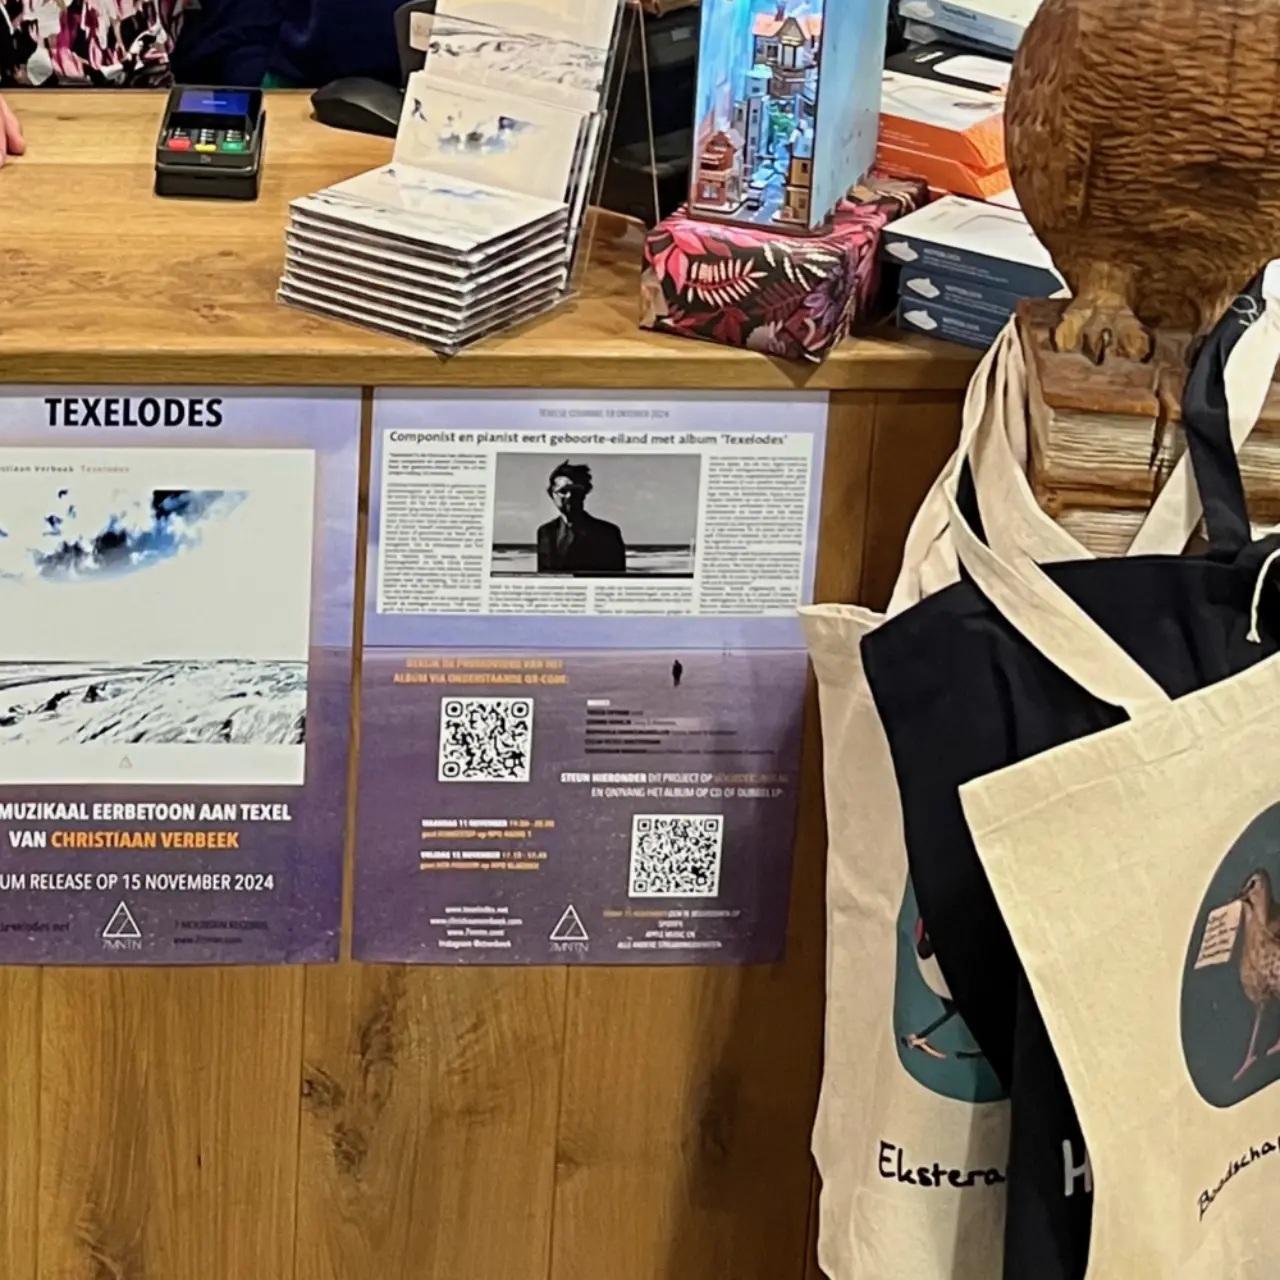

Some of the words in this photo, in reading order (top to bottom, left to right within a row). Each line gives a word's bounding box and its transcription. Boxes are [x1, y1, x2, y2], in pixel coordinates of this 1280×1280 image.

[45, 398, 223, 427] TEXELODES
[390, 431, 455, 444] Componist
[459, 434, 474, 443] en
[476, 432, 518, 446] pianist
[522, 434, 546, 444] eert
[550, 432, 647, 447] geboorte-eiland
[651, 434, 675, 444] met
[678, 432, 718, 445] album
[92, 803, 195, 821] EERBETOON
[198, 804, 236, 821] AAN
[239, 804, 291, 821] TEXEL
[9, 831, 46, 848] VAN
[51, 831, 156, 848] CHRISTIAAN
[160, 832, 239, 848] VERBEEK
[29, 874, 92, 890] RELEASE
[96, 874, 118, 890] OP
[123, 874, 141, 890] 15
[145, 874, 231, 890] NOVEMBER
[234, 874, 274, 890] 2024
[878, 1140, 1007, 1189] Ekstera
